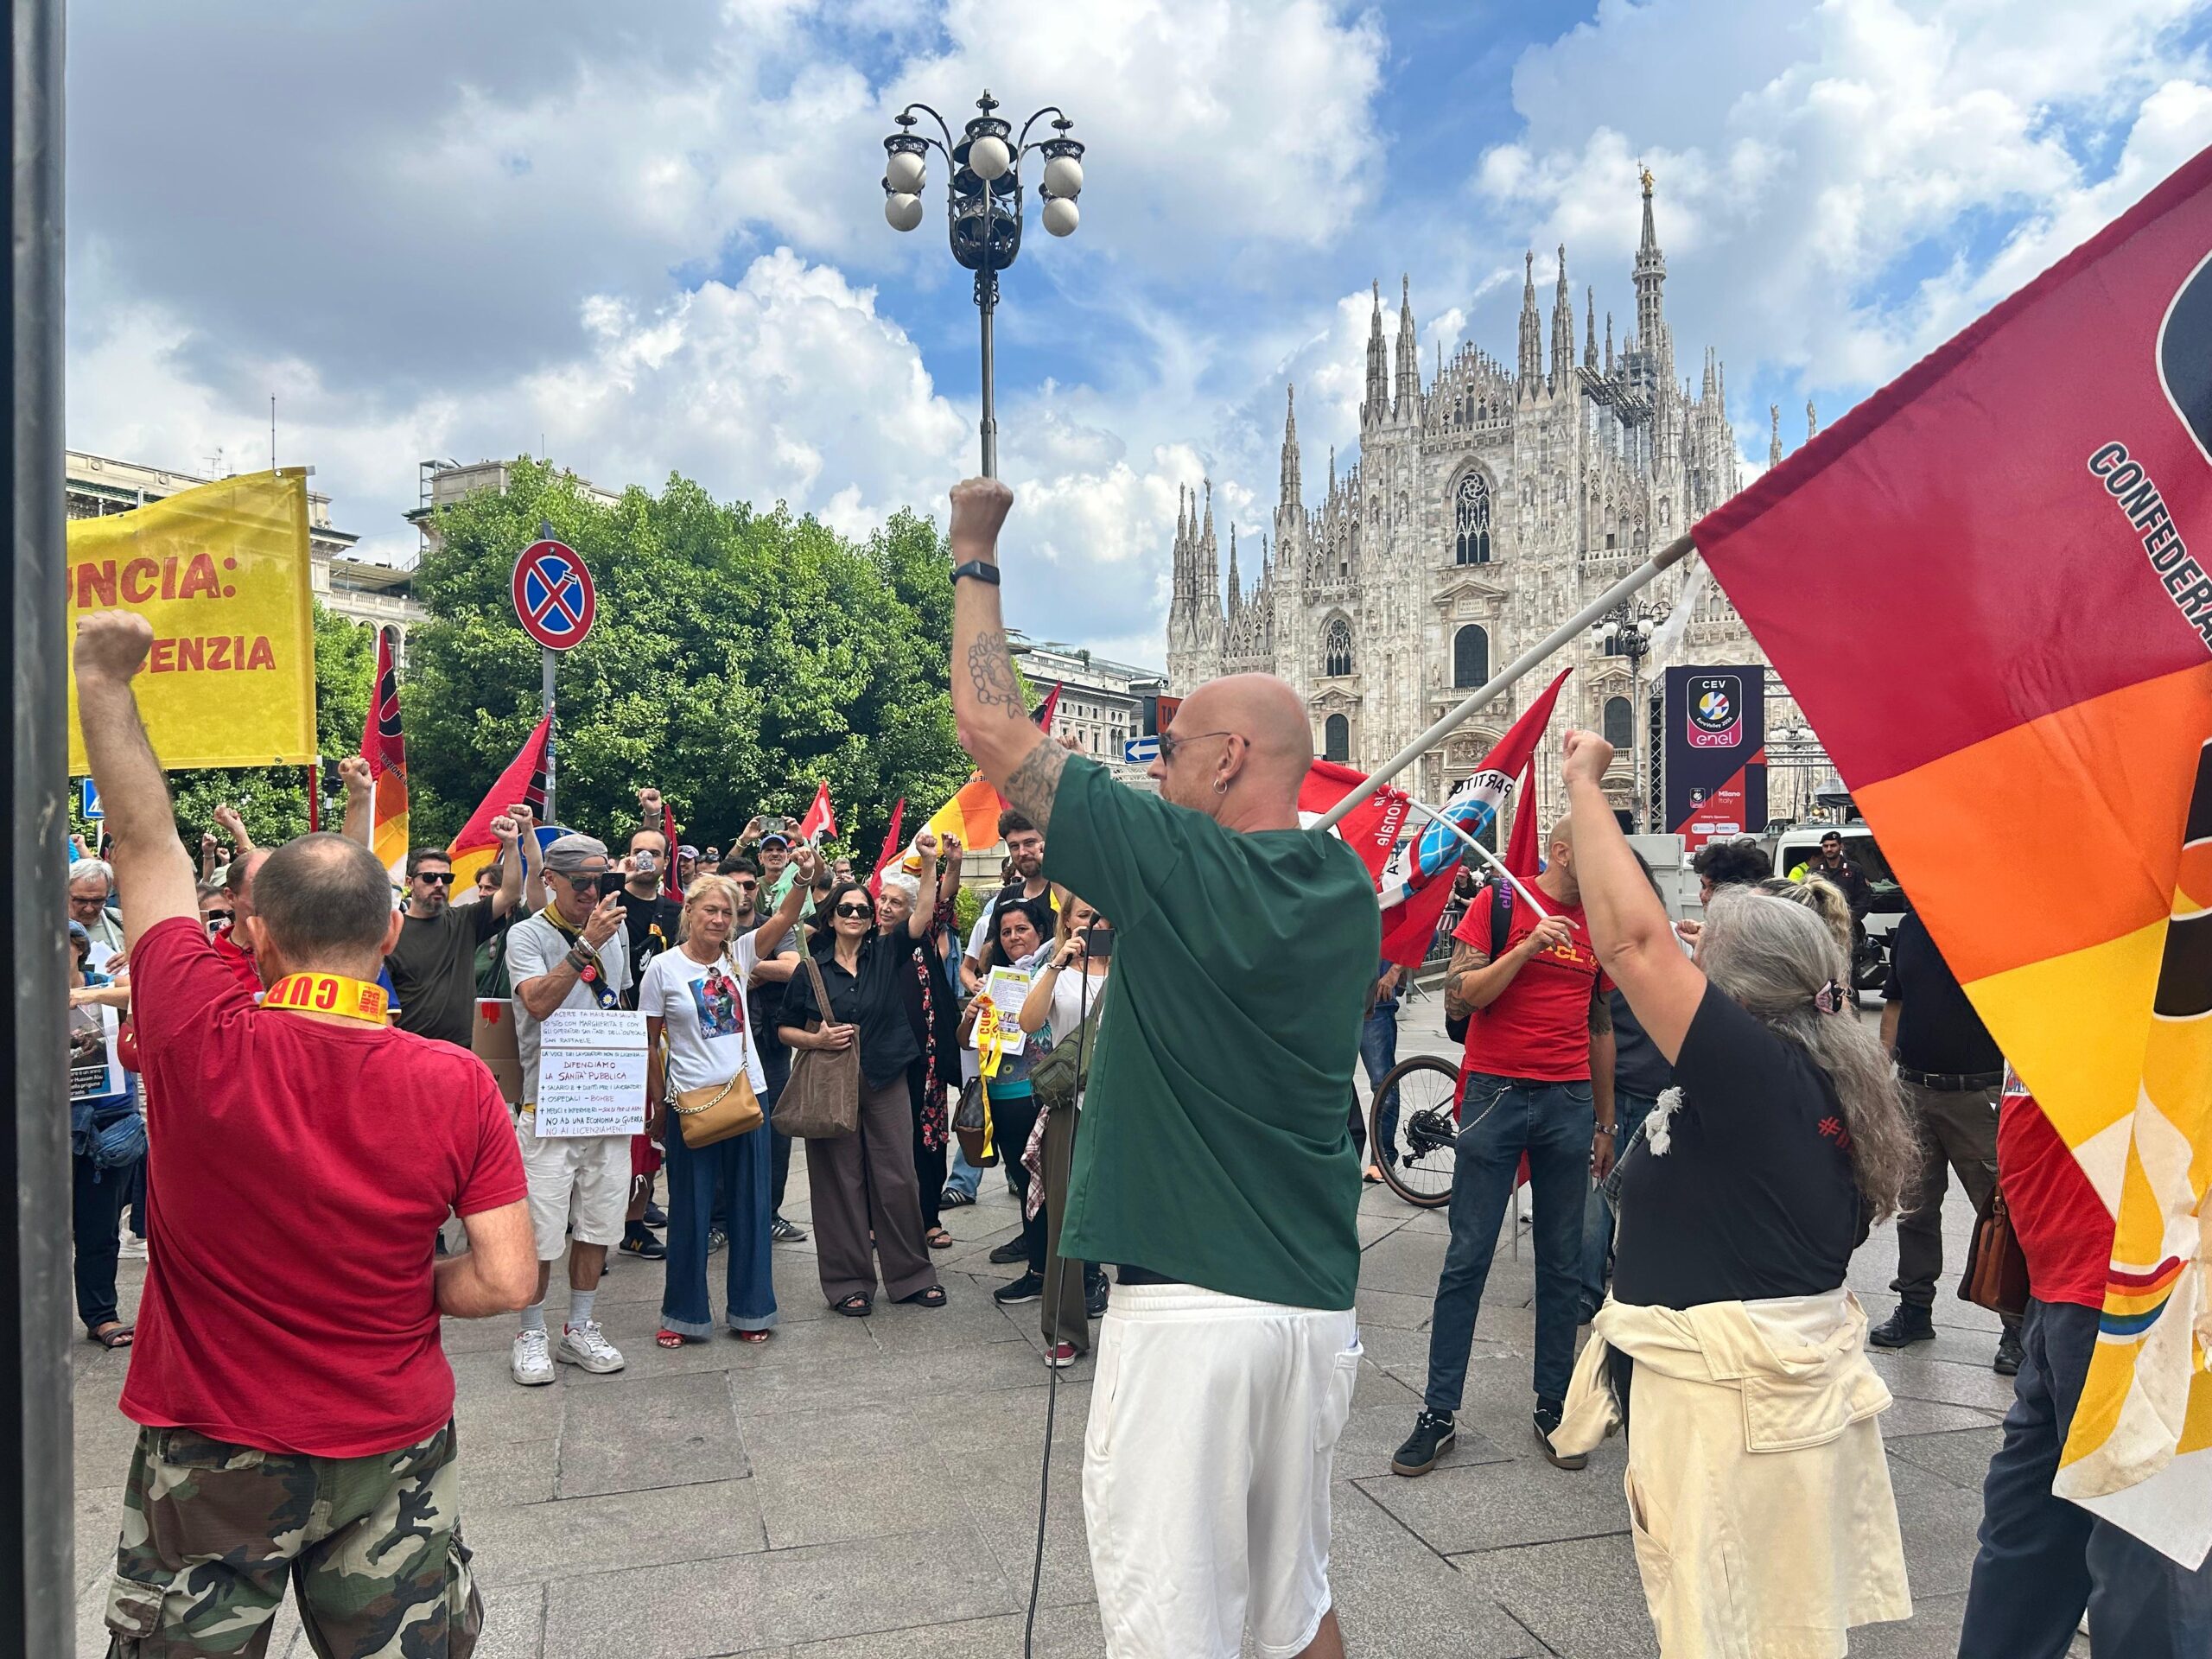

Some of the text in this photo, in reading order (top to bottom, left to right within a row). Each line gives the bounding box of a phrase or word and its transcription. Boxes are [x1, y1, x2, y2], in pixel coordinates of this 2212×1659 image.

[67, 553, 238, 608] NCIA:
[134, 635, 276, 674] ENZIA
[1701, 680, 1726, 689] CEV
[1696, 732, 1733, 745] enel
[267, 976, 339, 1009] CUB
[563, 1061, 616, 1070] DIFENDIAMO
[588, 1071, 626, 1080] PUBBLICA
[545, 1117, 558, 1126] NO
[622, 1116, 644, 1126] GUERRA
[545, 1127, 557, 1135] NO
